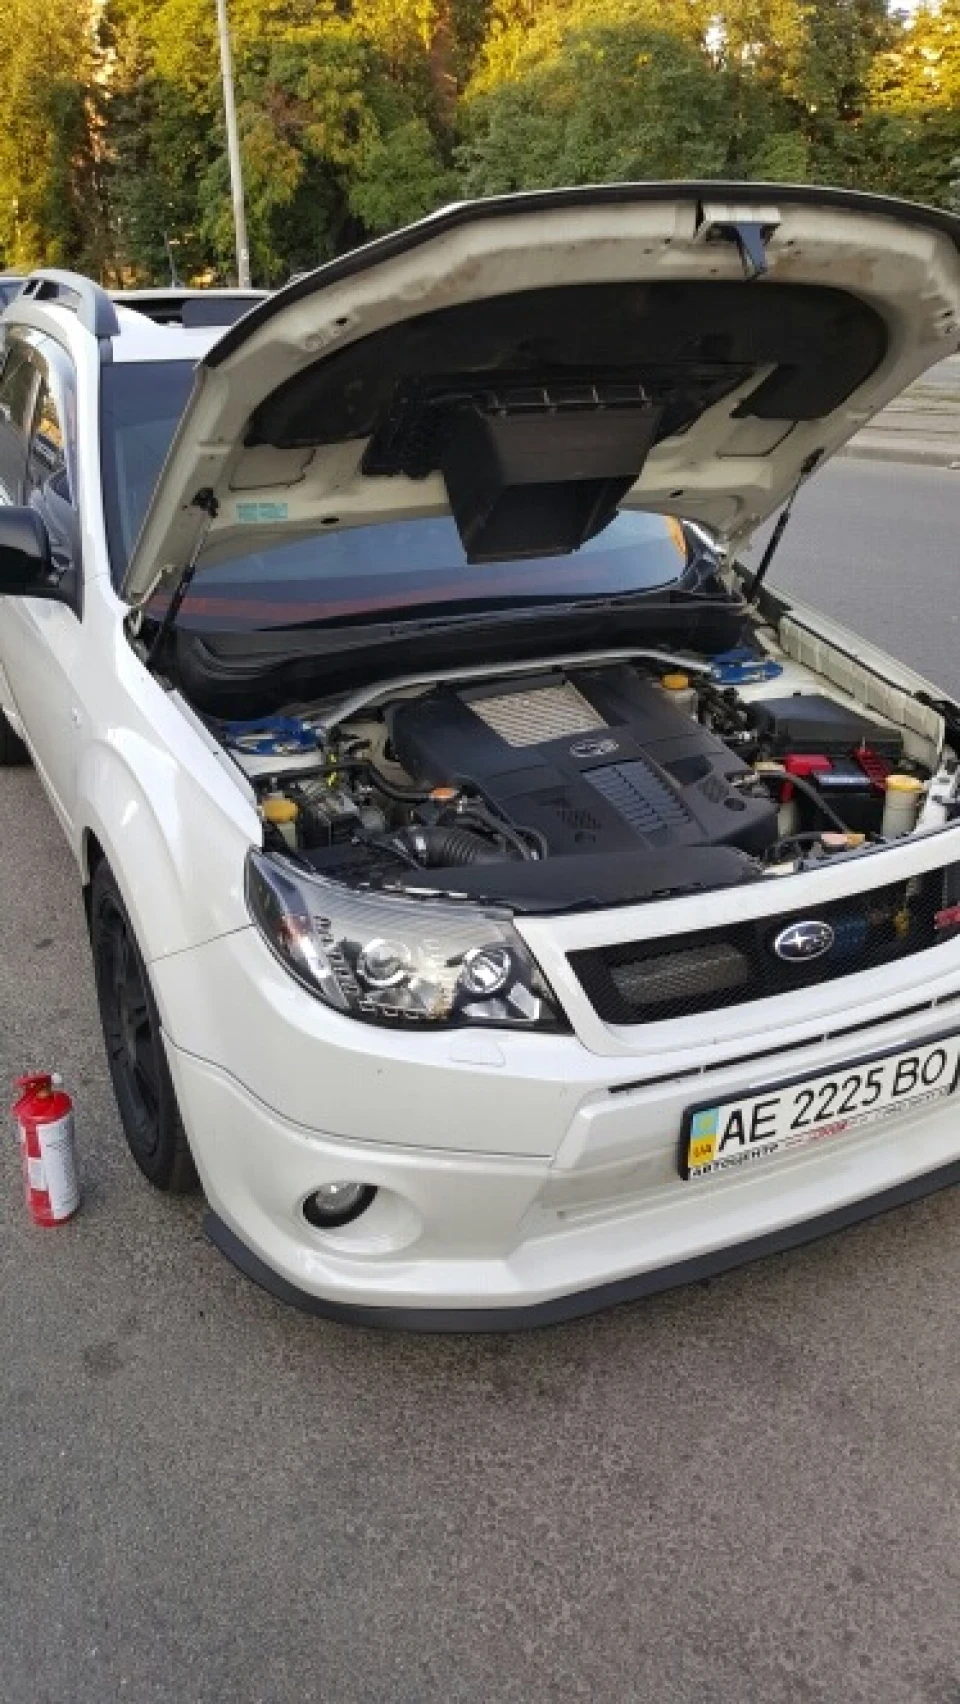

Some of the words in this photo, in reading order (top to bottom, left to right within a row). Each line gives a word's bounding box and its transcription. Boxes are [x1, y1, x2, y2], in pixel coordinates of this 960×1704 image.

[718, 1098, 781, 1152] AE
[790, 1066, 885, 1130] 2225
[892, 1048, 947, 1097] BO
